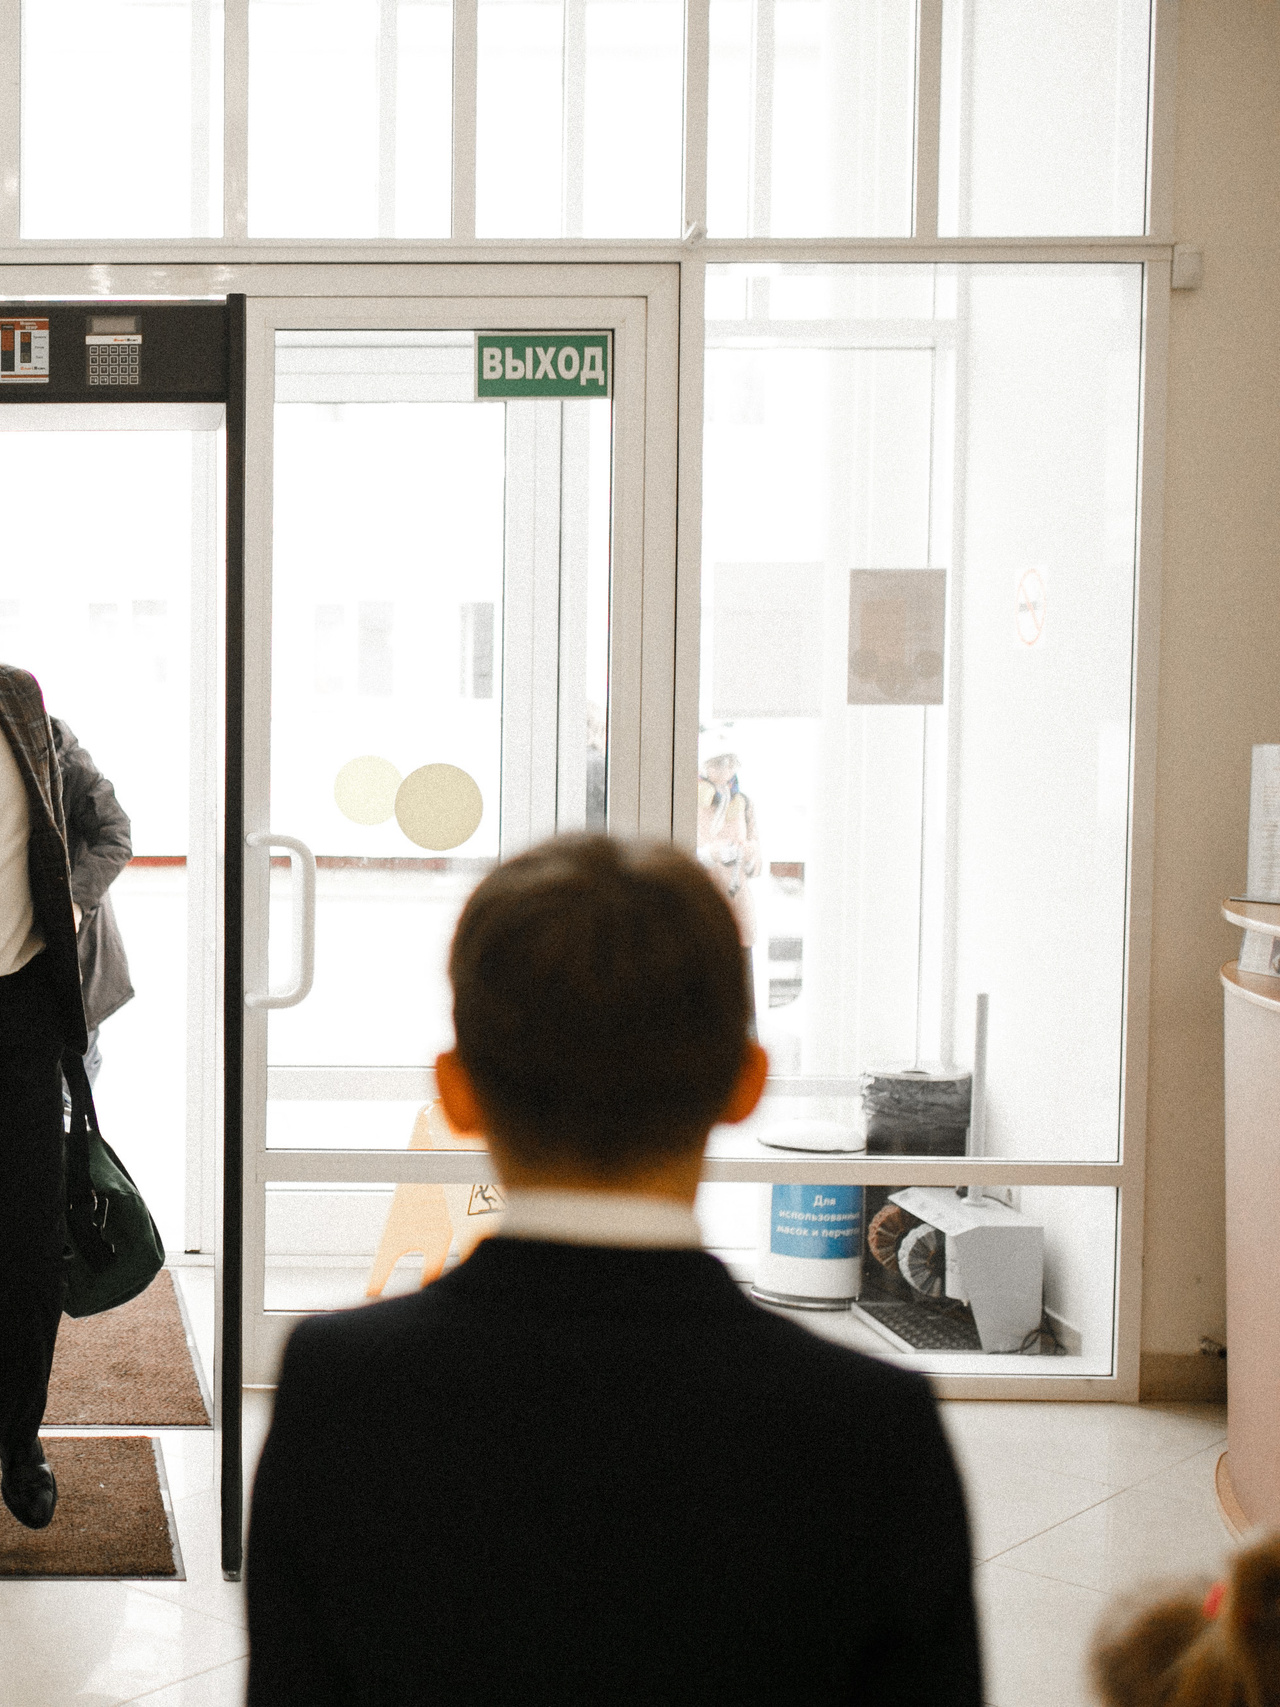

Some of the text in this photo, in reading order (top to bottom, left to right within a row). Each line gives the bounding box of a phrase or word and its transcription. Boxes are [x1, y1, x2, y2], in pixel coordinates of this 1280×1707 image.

[483, 346, 605, 386] ВЫХОД
[813, 1194, 836, 1207] Для
[779, 1210, 860, 1222] использованн
[776, 1225, 809, 1237] масок
